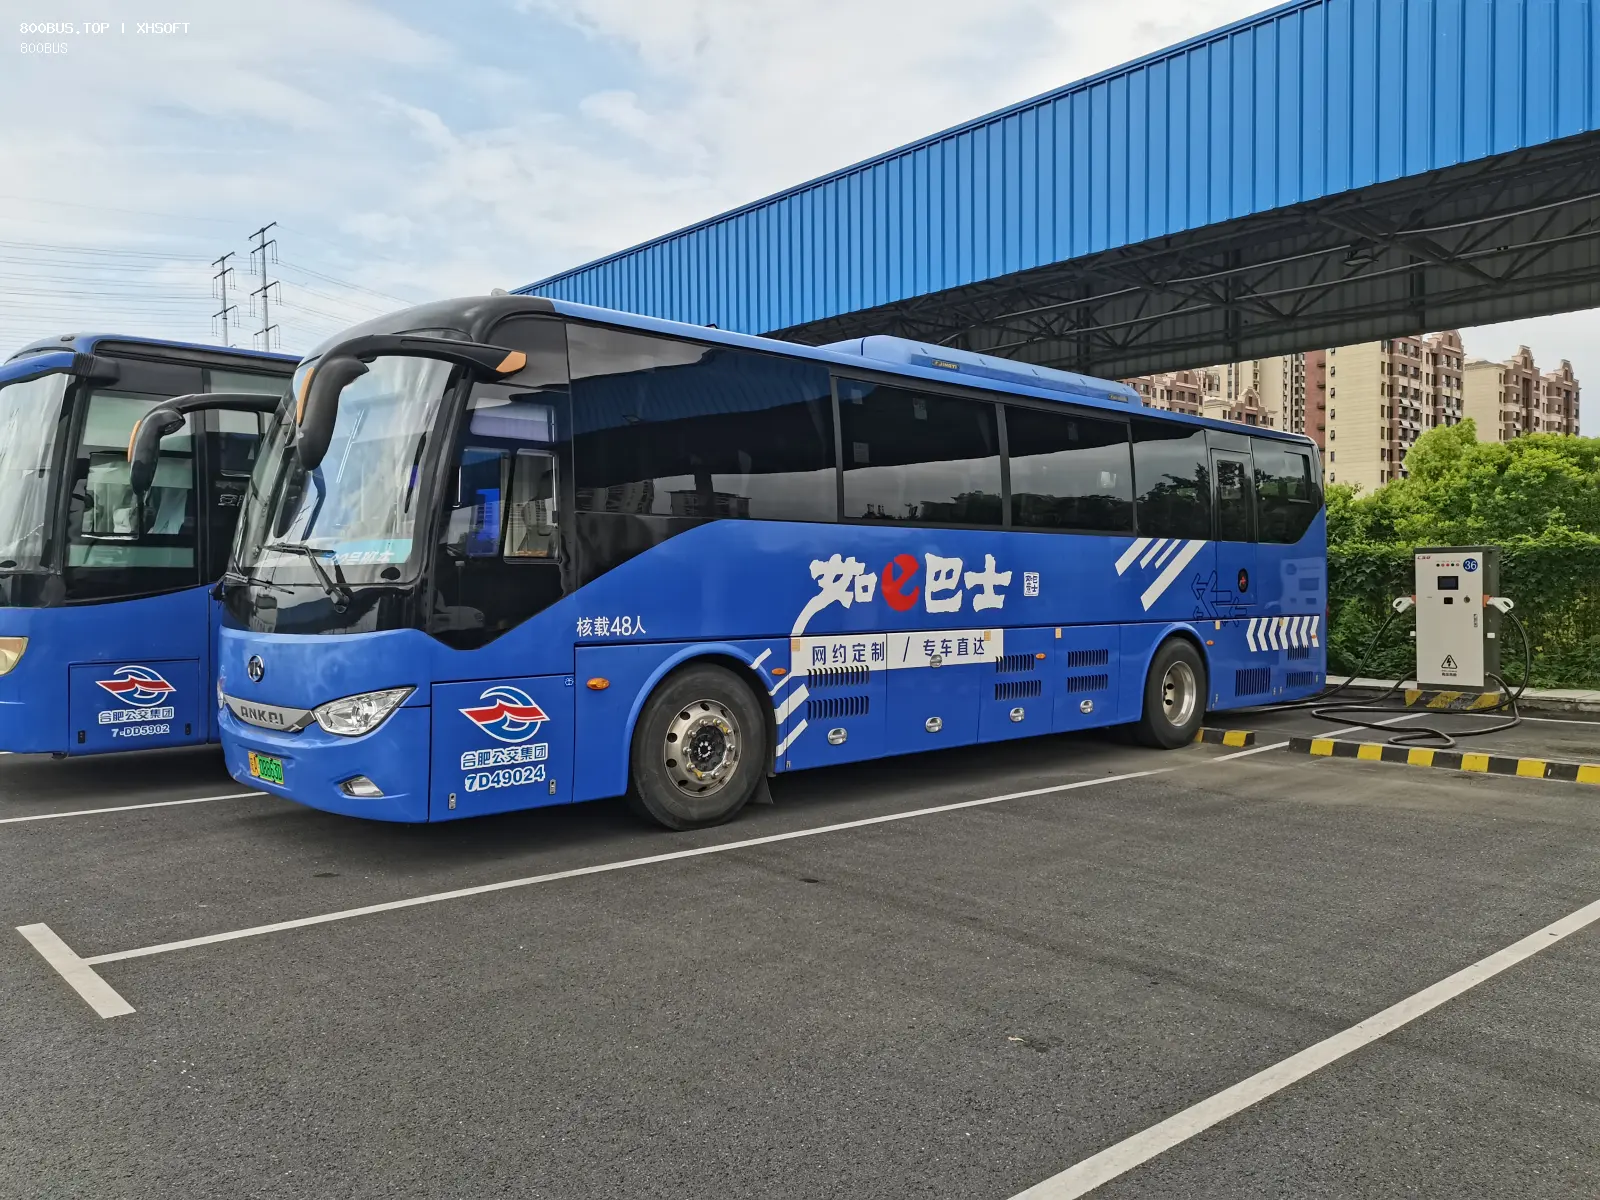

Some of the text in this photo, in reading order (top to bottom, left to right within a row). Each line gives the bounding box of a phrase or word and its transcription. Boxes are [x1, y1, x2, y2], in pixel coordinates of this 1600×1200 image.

[1464, 560, 1477, 570] 36
[576, 615, 647, 638] 核载48人
[811, 641, 886, 667] 网约定制
[922, 636, 985, 658] 专车直达
[98, 706, 175, 725] 合肥公交集团
[240, 705, 285, 726] ANKAI
[111, 724, 170, 738] 7-DD5902
[461, 743, 548, 770] 合肥公交集团
[465, 764, 546, 793] 7D49024
